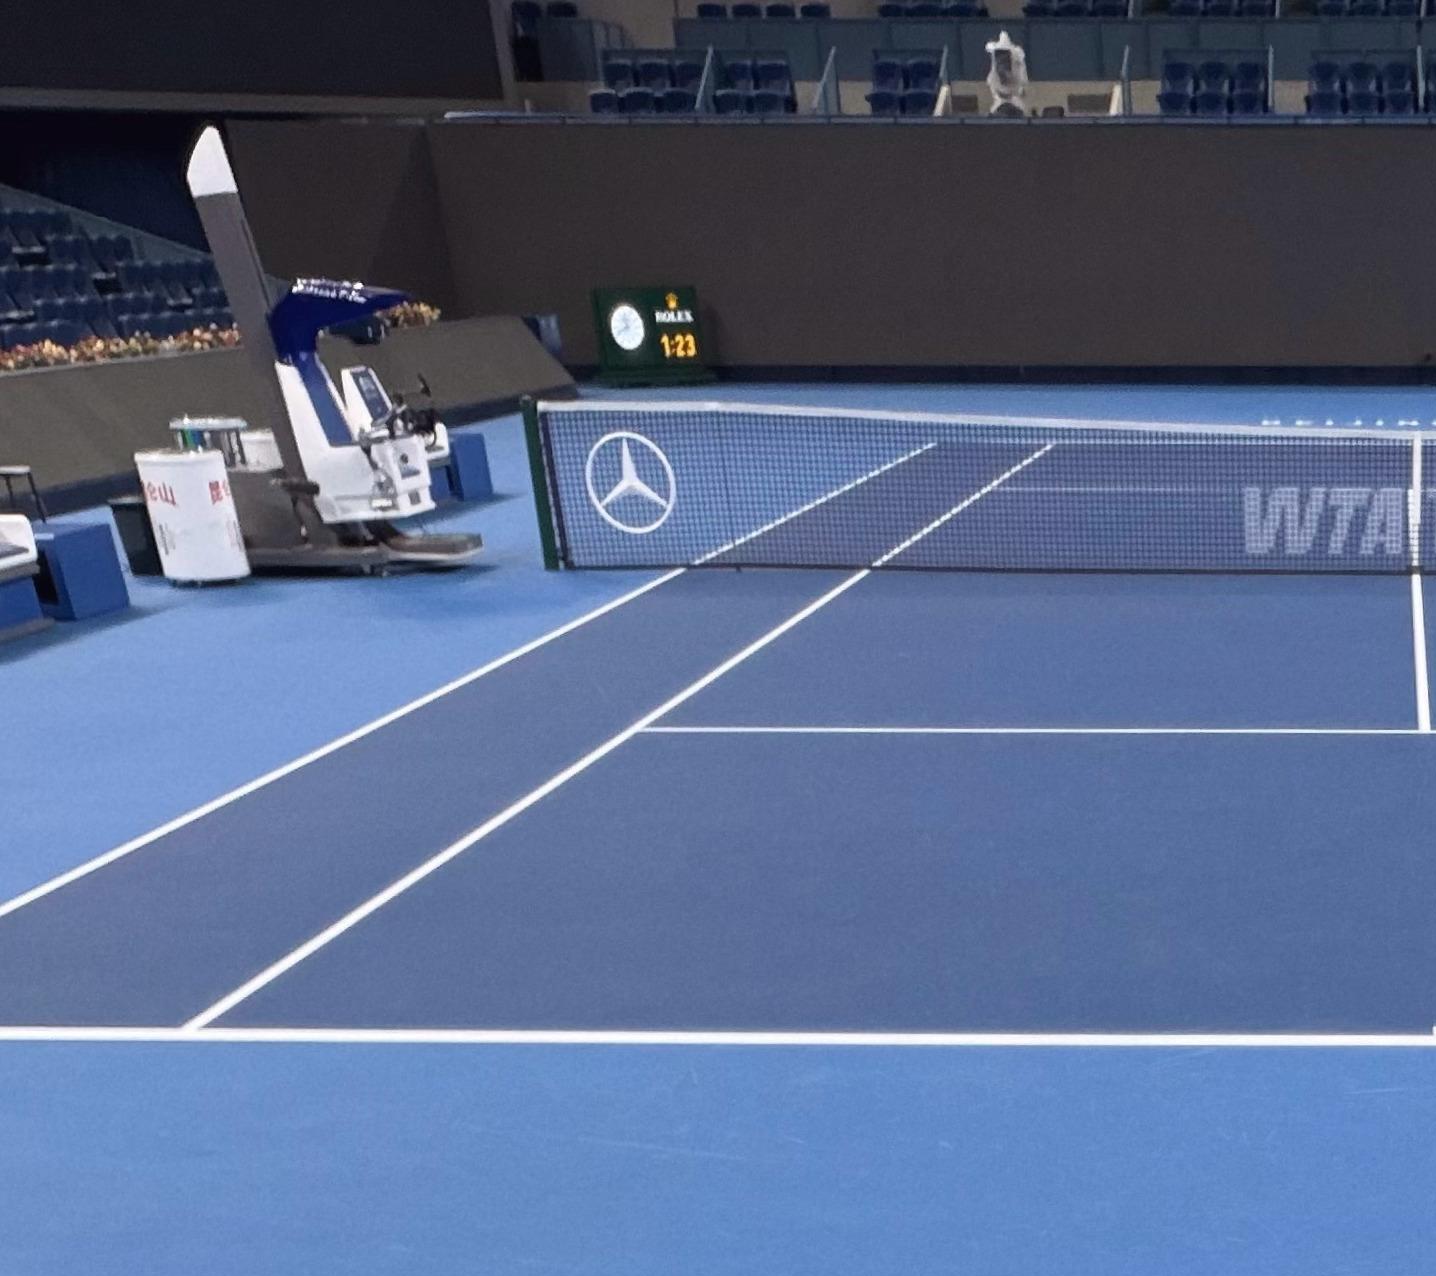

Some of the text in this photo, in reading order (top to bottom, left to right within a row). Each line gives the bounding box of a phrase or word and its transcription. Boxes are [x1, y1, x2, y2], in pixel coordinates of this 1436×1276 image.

[655, 310, 694, 323] ROLEX
[660, 333, 697, 358] 1:23
[1244, 487, 1402, 554] WTA
